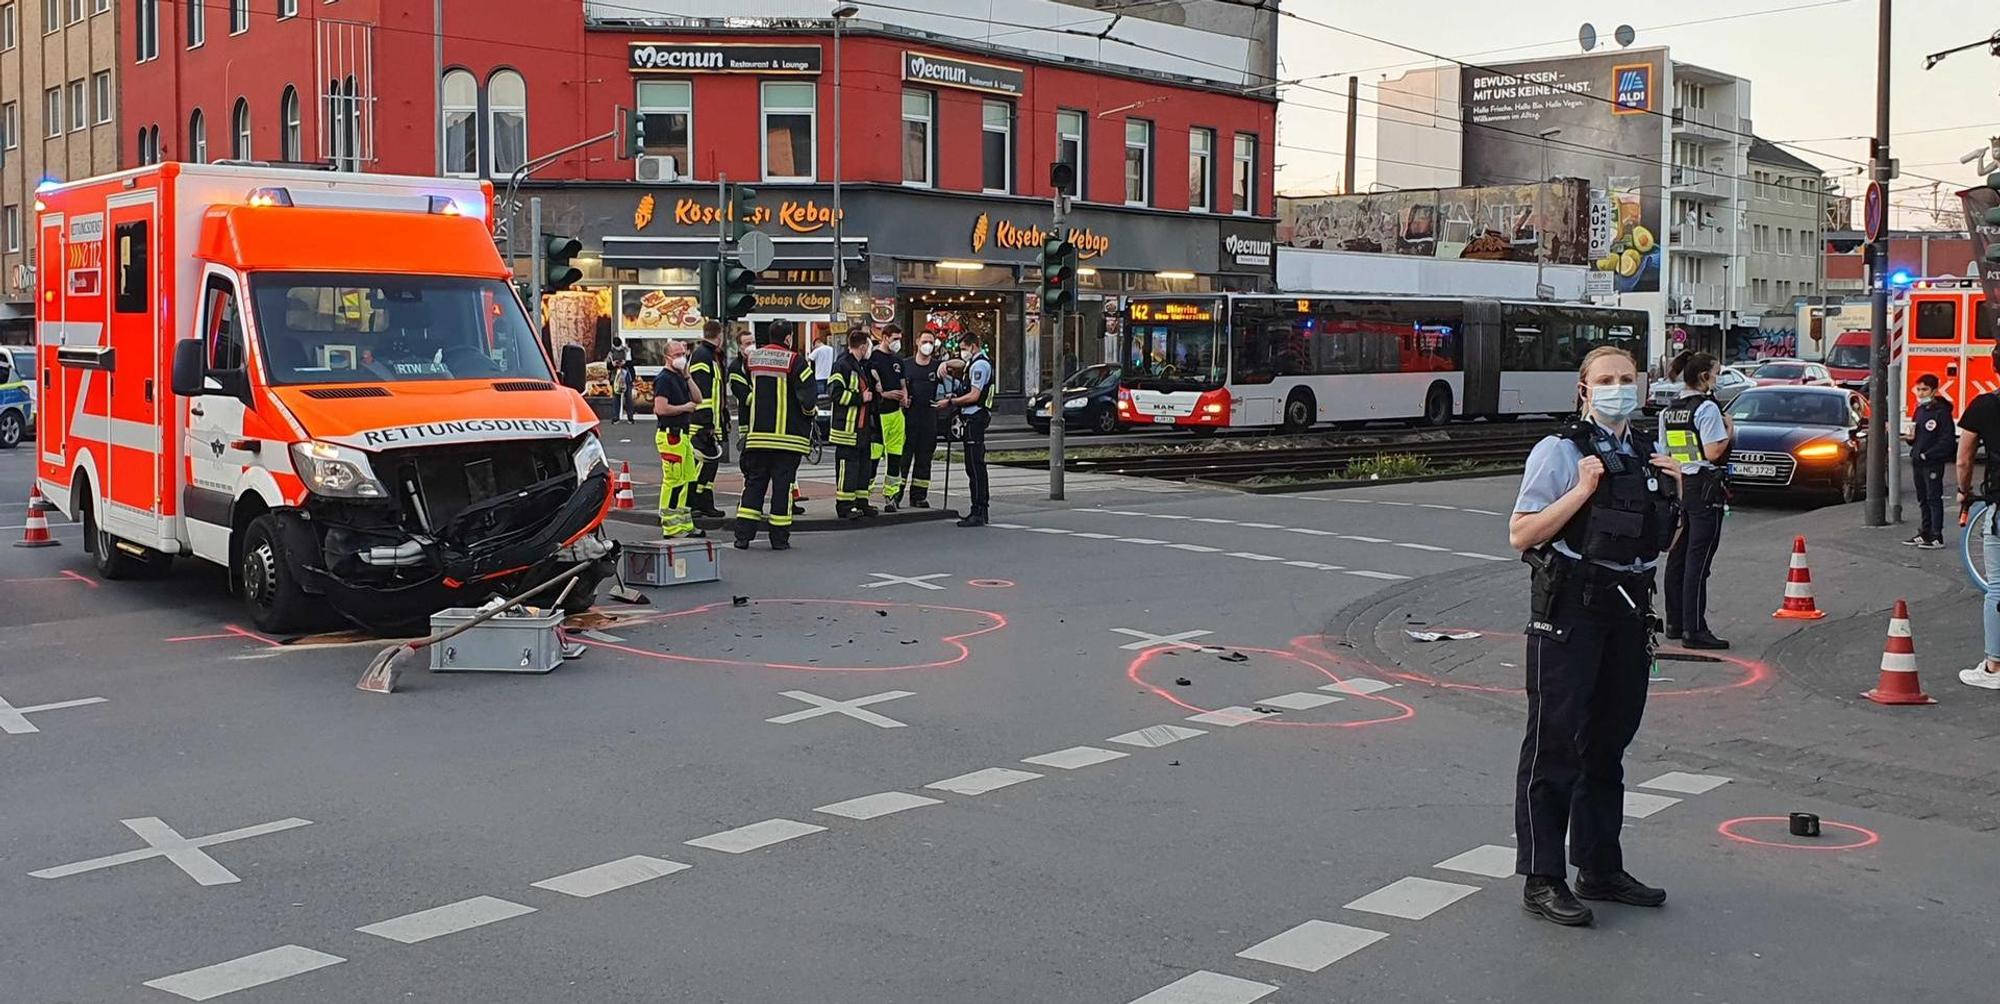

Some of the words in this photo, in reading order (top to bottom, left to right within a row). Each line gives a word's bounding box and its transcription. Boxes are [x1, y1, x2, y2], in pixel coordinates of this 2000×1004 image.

[634, 46, 724, 68] Mecnun
[730, 60, 769, 68] Restaurant
[782, 61, 809, 70] Lounge
[911, 57, 966, 83] Mecnun
[1473, 74, 1521, 89] BEWUSST
[1524, 71, 1557, 84] ESSEN
[1473, 89, 1492, 101] MIT
[1493, 88, 1516, 99] UNS
[1518, 86, 1551, 97] KEINE
[1552, 81, 1591, 94] KUNST.
[1618, 91, 1645, 102] ALDI
[1473, 106, 1489, 114] Hallo
[1490, 104, 1513, 112] Frische.
[1514, 102, 1531, 111] Hallo
[1545, 100, 1561, 108] Hallo
[1562, 99, 1584, 108] Vegan.
[1473, 113, 1511, 123] Willkommen
[675, 199, 772, 225] Köşeşı
[779, 200, 844, 232] Kebap
[1591, 204, 1600, 249] AUTO
[997, 219, 1047, 249] Köşeb
[1067, 228, 1109, 259] Kebap
[1226, 234, 1271, 255] Mecnun
[89, 241, 102, 267] 112
[755, 293, 793, 307] şebaşı
[796, 293, 831, 310] Kebap
[1297, 300, 1311, 312] 142
[1130, 304, 1149, 320] 142
[1664, 409, 1691, 424] POLIZEI
[364, 420, 572, 446] RETTUNGSDIENST
[1732, 465, 1738, 473] K
[1533, 621, 1553, 632] POLIZEI
